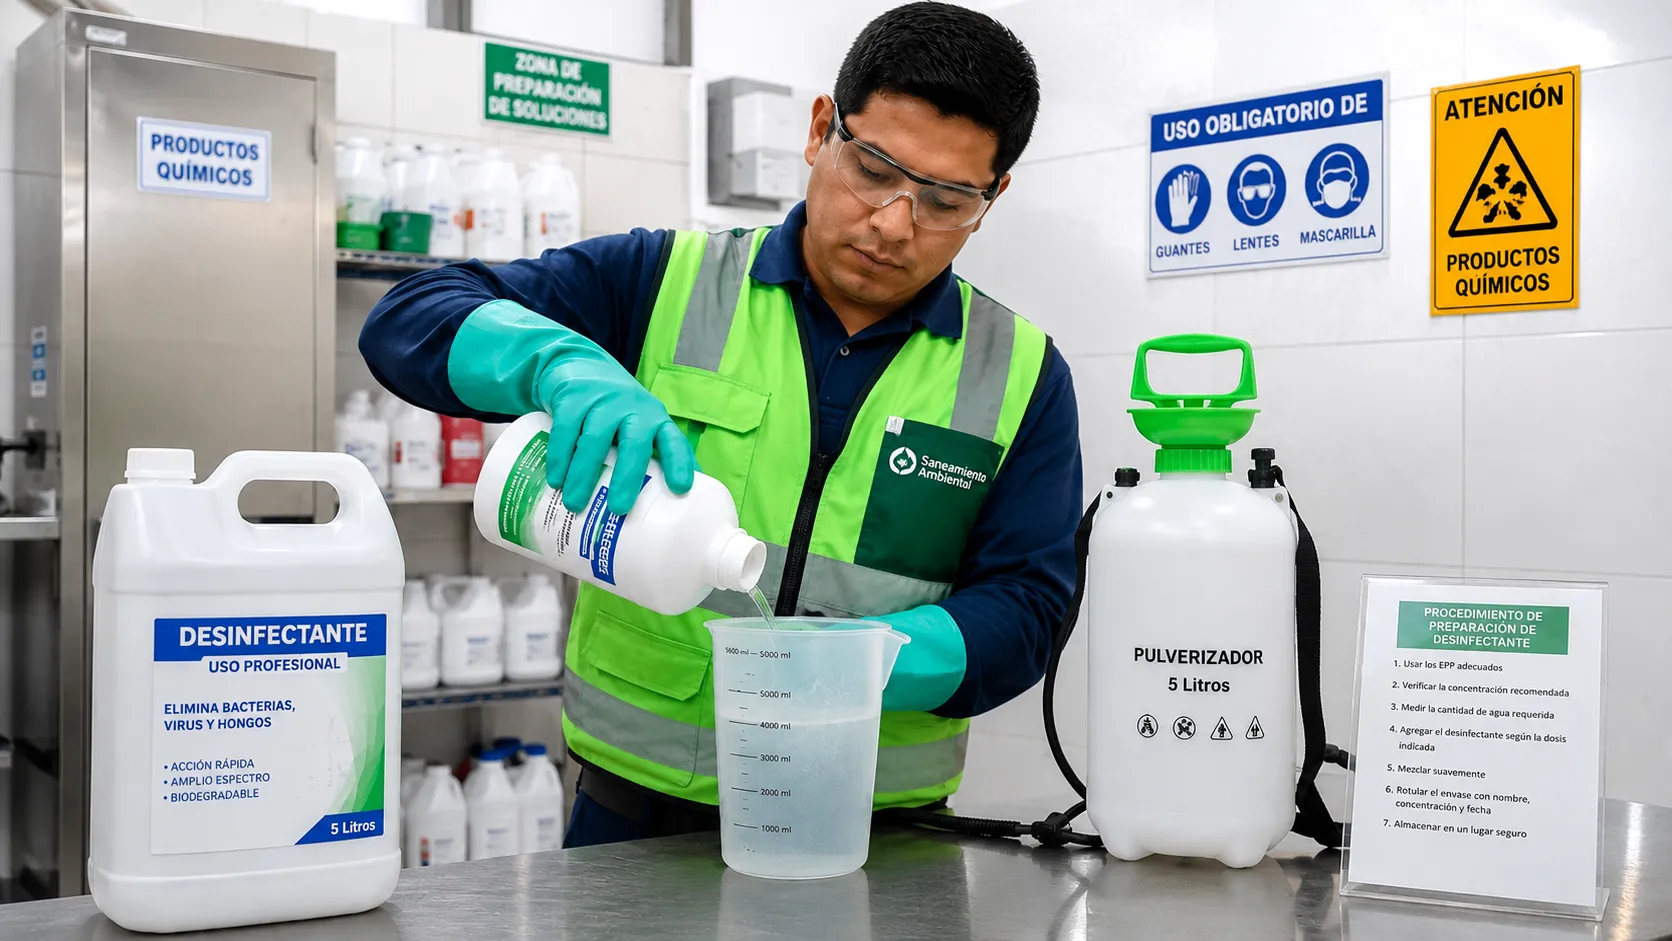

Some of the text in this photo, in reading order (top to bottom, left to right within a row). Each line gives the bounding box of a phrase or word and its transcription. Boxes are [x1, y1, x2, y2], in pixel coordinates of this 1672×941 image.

[515, 52, 582, 80] ZONA DE
[493, 72, 602, 106] PREPARACIÓN
[1444, 83, 1563, 121] ATENCIÓN
[488, 95, 607, 130] DE SOLUCIONES
[1163, 93, 1368, 141] USO OBLIGATORIO DE
[151, 133, 259, 160] PRODUCTOS
[157, 159, 252, 186] QUÍMICOS
[1300, 224, 1376, 244] MASCARILLA
[1156, 241, 1210, 258] GUANTES
[1233, 234, 1279, 251] LENTES
[1447, 246, 1560, 271] PRODUCTOS
[1455, 273, 1550, 297] QUÍMICOS
[921, 455, 986, 483] Saneamiento
[1424, 607, 1543, 622] PROCEDIMIENTO DE
[180, 623, 367, 646] DESINFECTANTE
[1429, 620, 1536, 635] PREPARACIÓN DE
[1433, 634, 1530, 648] DESINFECTANTE
[760, 650, 791, 659] 5000 ml
[1134, 647, 1263, 665] PULVERIZADOR
[209, 657, 341, 673] USO PROFESIONAL
[1394, 660, 1400, 668] 1.
[1404, 660, 1423, 668] Usar
[1425, 661, 1437, 669] los
[1457, 662, 1503, 672] adecuados
[1168, 677, 1230, 692] 5 Litros
[1392, 681, 1570, 698] 2. Verificar la concentración recomendada
[760, 691, 791, 699] 5000 ml
[164, 699, 296, 714] ELIMINA BACTERIAS,
[1390, 703, 1555, 720] 3. Medir la cantidad de agua requerida
[164, 717, 272, 731] VIRUS Y HONGOS
[760, 722, 791, 730] 4000 ml
[1389, 725, 1567, 743] 4. Agregar el desinfectante según la dosis
[1399, 742, 1435, 752] indicada
[171, 758, 255, 771] ACCIÓN RÁPIDA
[760, 754, 791, 763] 3000 ml
[1387, 764, 1486, 778] 5. Mezclar suavemente
[171, 772, 270, 787] AMPLIO ESPECTRO
[171, 788, 259, 802] BIODEGRADABLE
[760, 789, 791, 797] 2000 ml
[1385, 785, 1394, 794] 6.
[1396, 786, 1428, 796] Rotular
[1430, 788, 1438, 797] el
[1440, 790, 1472, 800] envase
[1492, 793, 1530, 804] nombre,
[1396, 800, 1492, 815] concentración y fecha
[330, 820, 376, 835] 5 Litros
[761, 825, 792, 834] 1000 ml
[1383, 819, 1528, 839] 7. Almacenar en un lugar seguro
